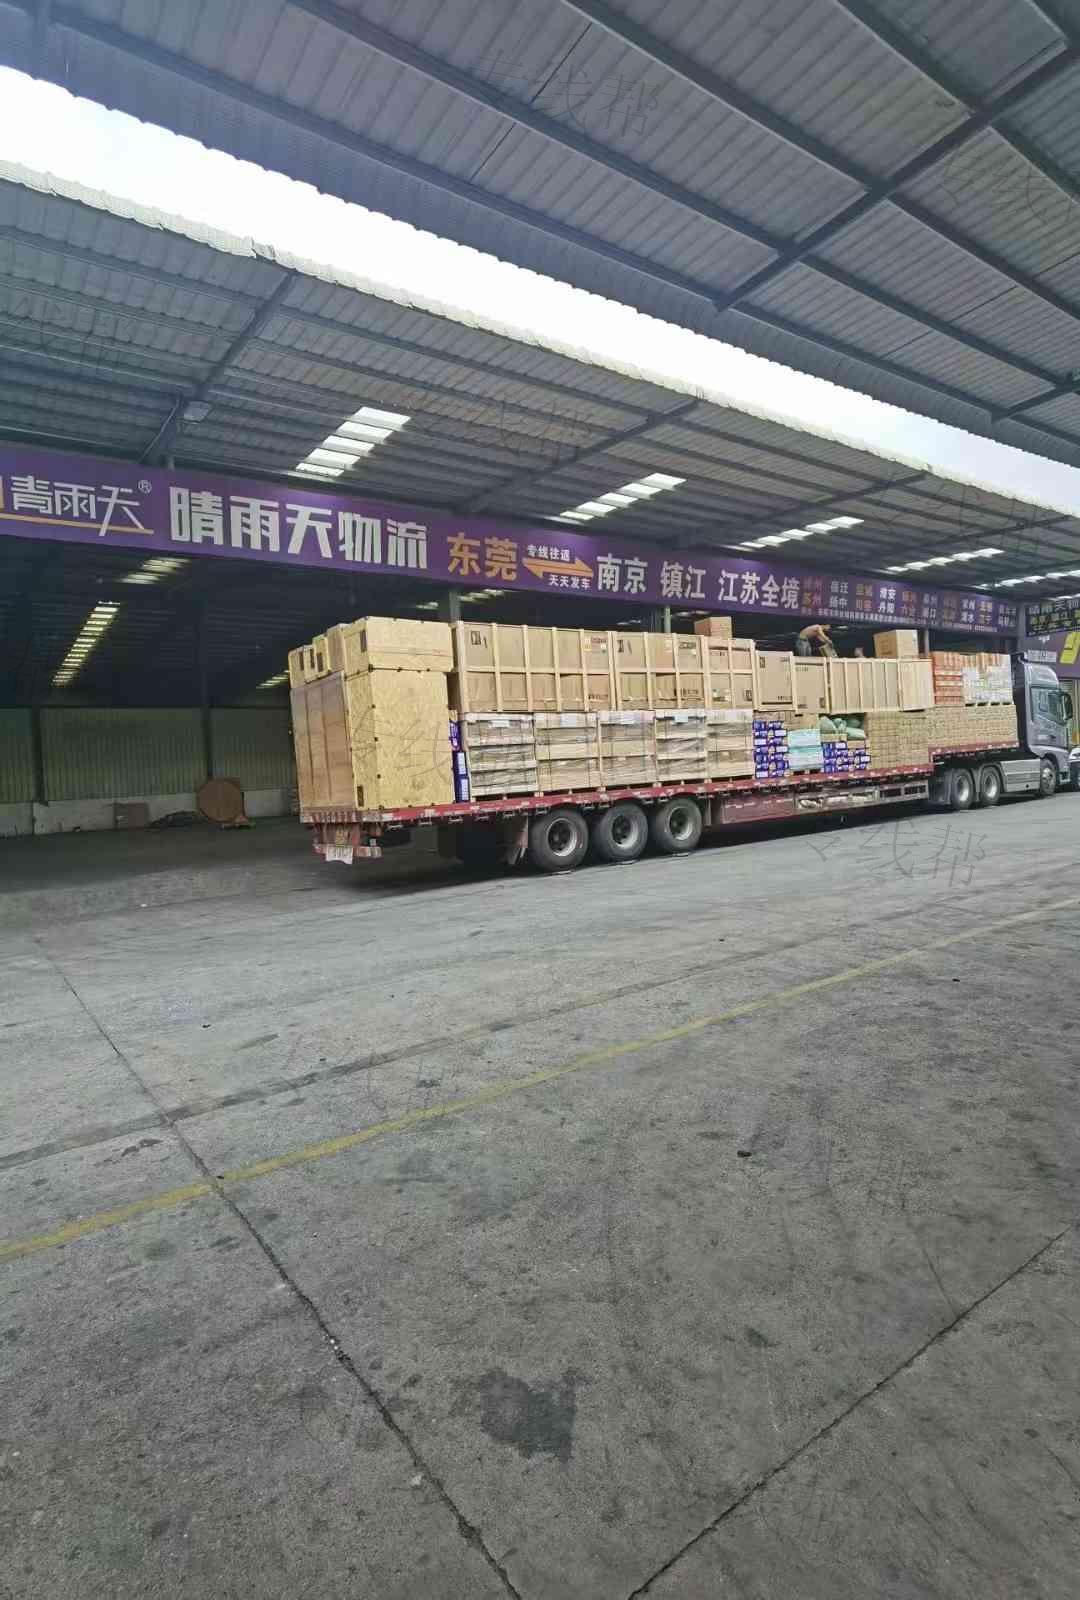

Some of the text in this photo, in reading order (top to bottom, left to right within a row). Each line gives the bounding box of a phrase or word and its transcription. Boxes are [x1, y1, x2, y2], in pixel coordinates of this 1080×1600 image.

[169, 487, 428, 569] 晴雨天物流
[446, 532, 519, 582] 东莞
[548, 573, 592, 590] 天天发车
[596, 553, 801, 610] 南京 镇江 江苏全境
